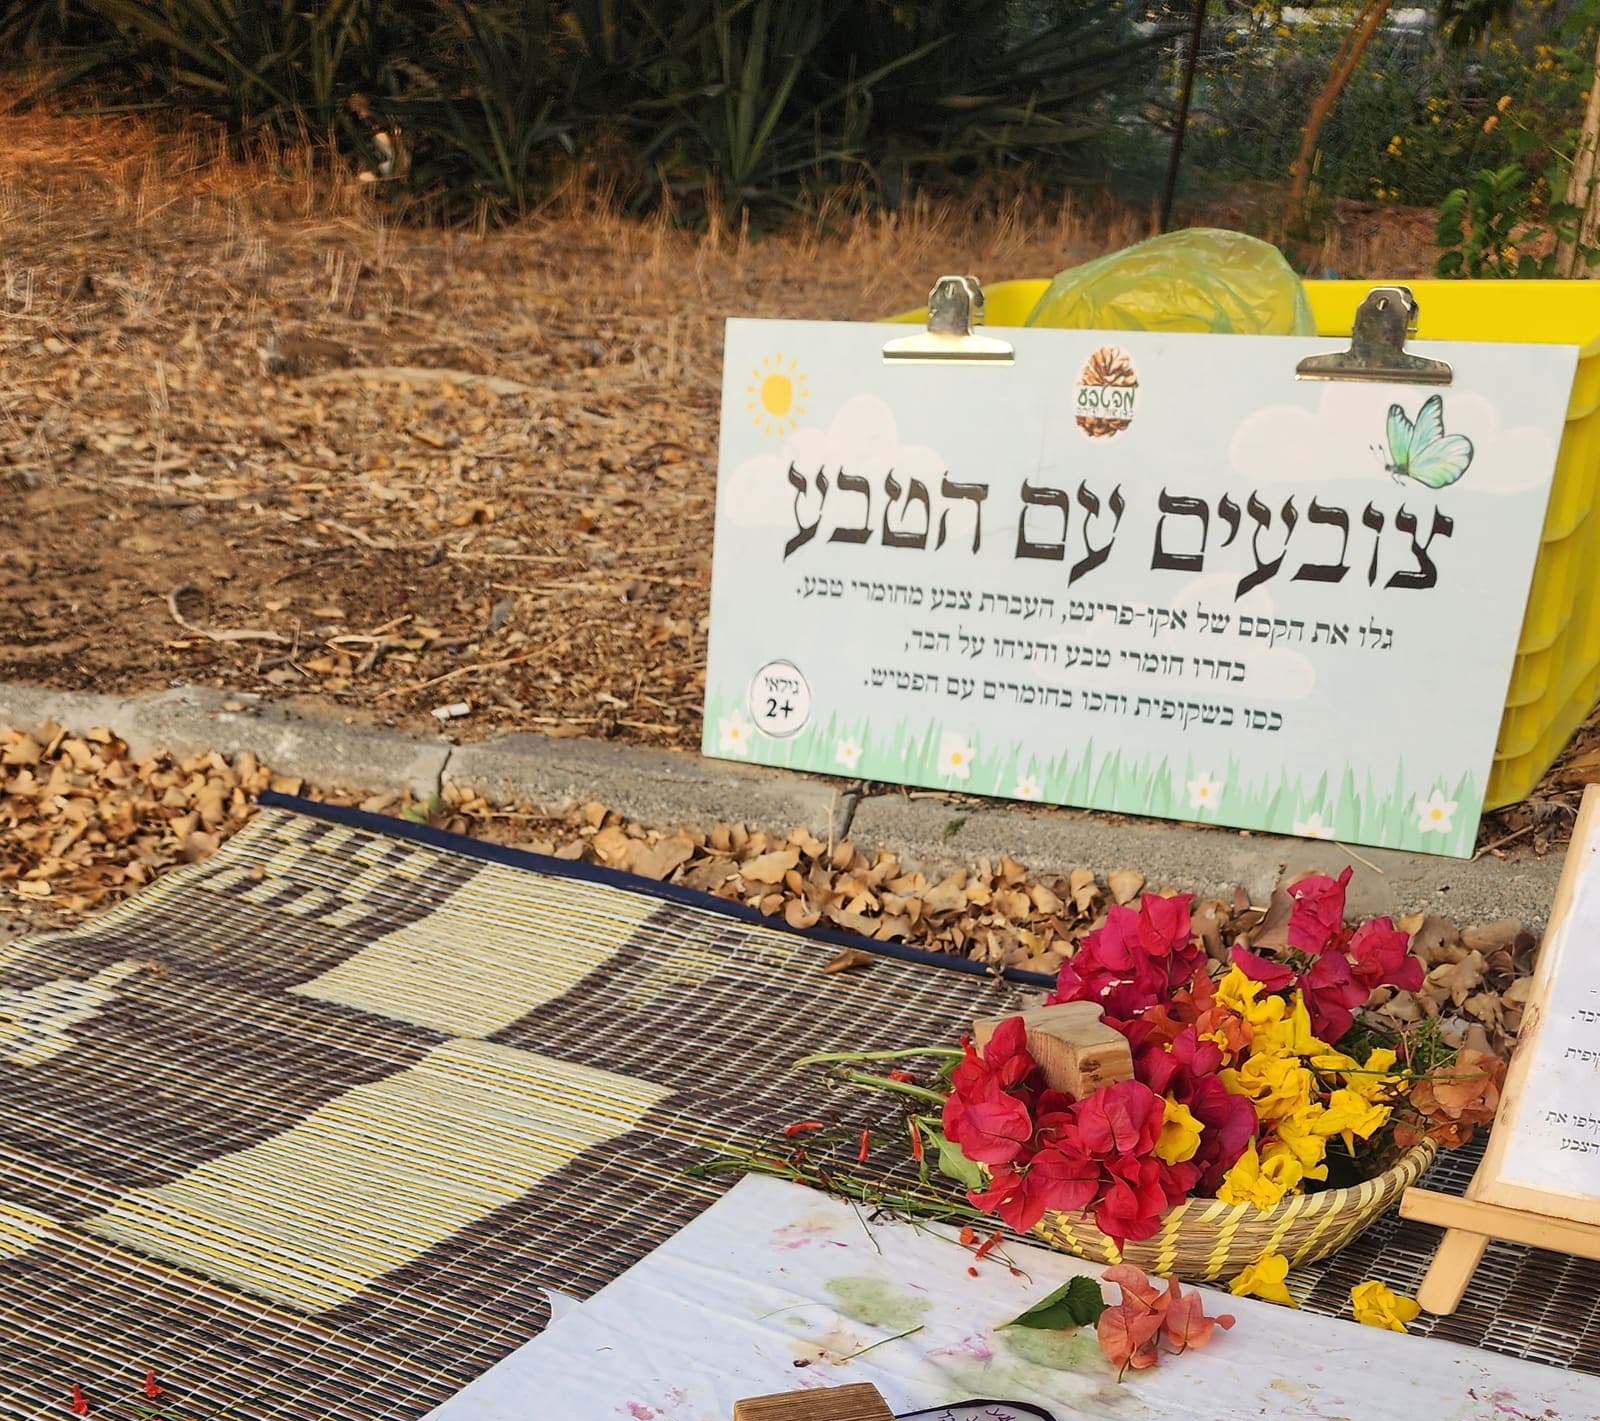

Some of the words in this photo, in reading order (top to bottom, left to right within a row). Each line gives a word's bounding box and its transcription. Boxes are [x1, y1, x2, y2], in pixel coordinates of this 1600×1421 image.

[783, 460, 989, 560] הטבע
[1015, 478, 1125, 588] עם
[1150, 486, 1454, 602] צובעים
[796, 575, 843, 599] טבע.
[851, 580, 923, 606] מחומרי
[931, 587, 972, 611] צבע
[979, 592, 1054, 620] העברת
[1061, 600, 1187, 637] אקו-פרינט,
[1196, 602, 1230, 634] של
[904, 629, 950, 652] הבד,
[958, 624, 985, 658] על
[1238, 616, 1305, 649] הקסם
[1311, 622, 1349, 646] את
[1359, 616, 1393, 649] גלו
[993, 637, 1057, 663] והניחו
[1064, 644, 1111, 669] טבע
[1120, 650, 1184, 675] חומרי
[864, 667, 938, 693] הפטיש.
[1193, 656, 1246, 682] בחרו
[946, 675, 975, 700] עם
[983, 679, 1073, 708] בחומרים
[1081, 691, 1127, 716] והכו
[1133, 697, 1234, 731] בשקופית
[1243, 707, 1283, 732] כסו
[1545, 1111, 1567, 1123] את
[1560, 1137, 1600, 1154] הצבע
